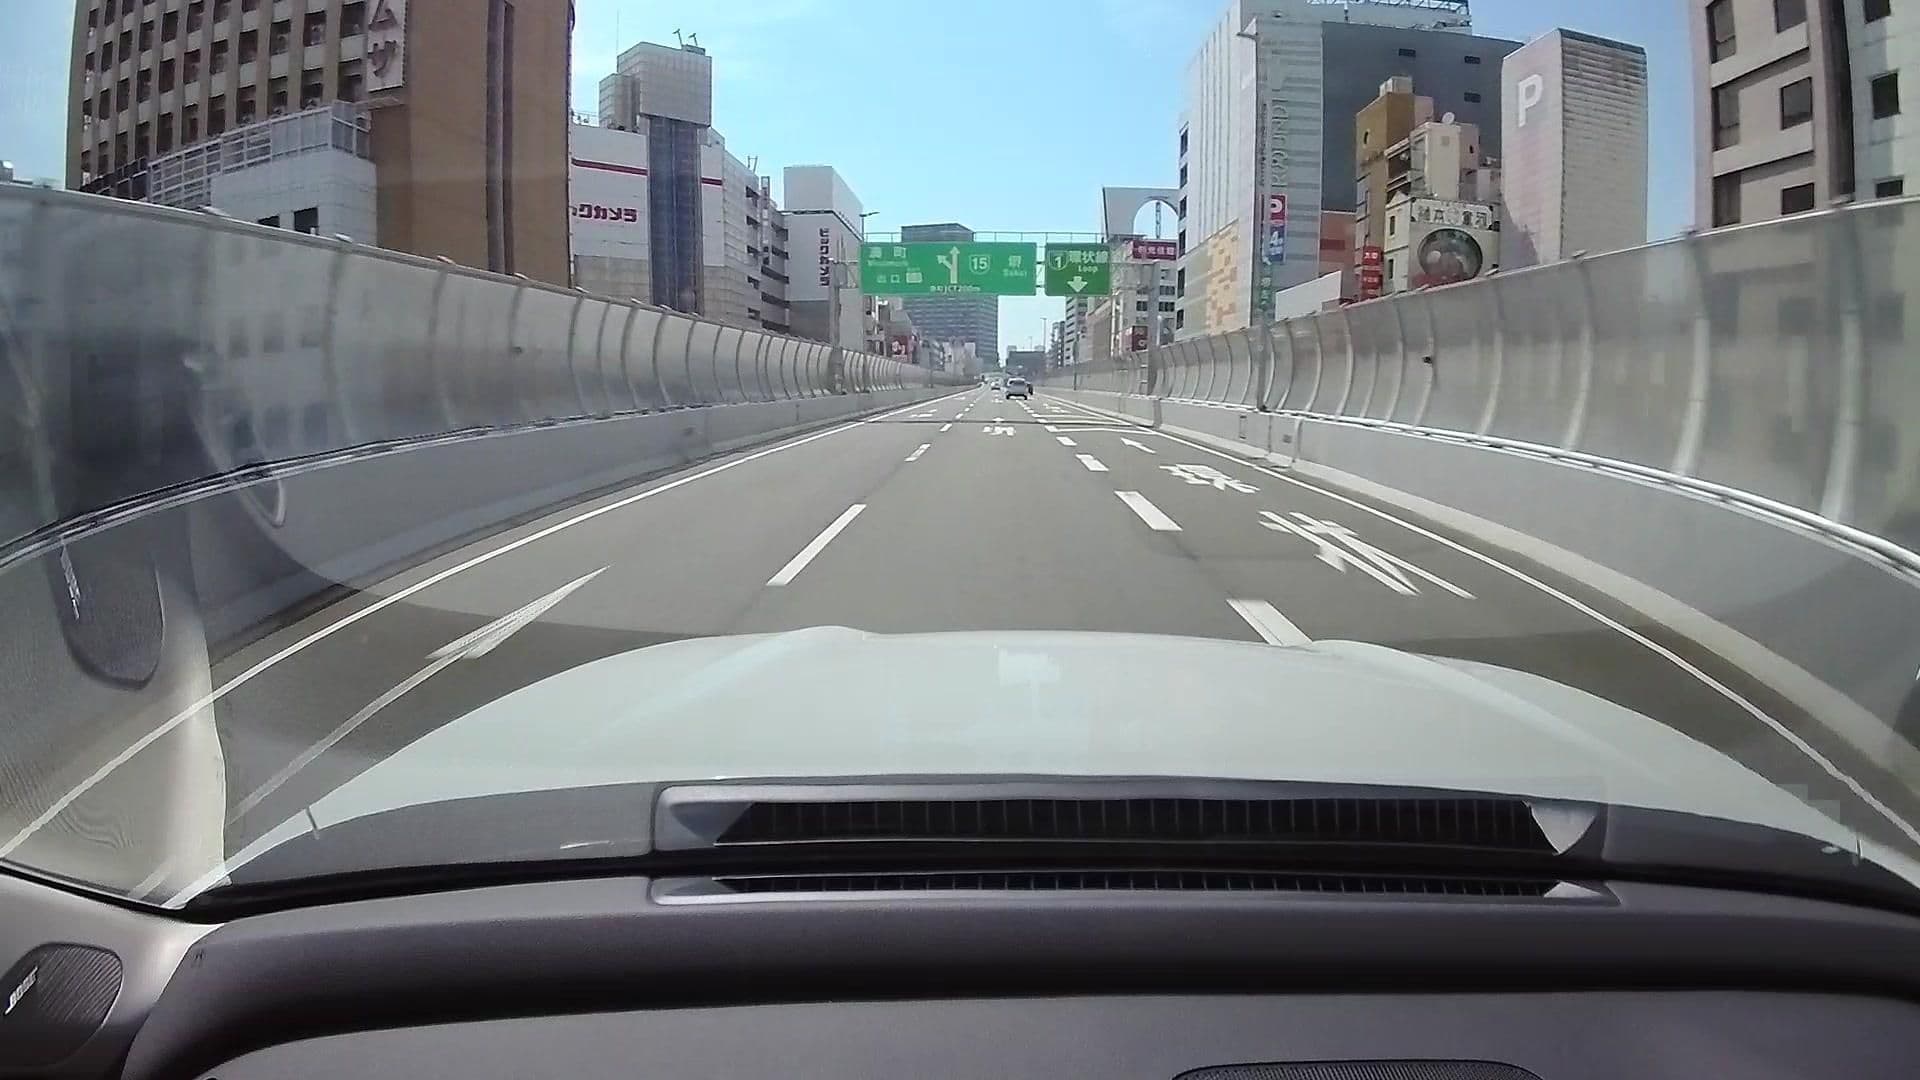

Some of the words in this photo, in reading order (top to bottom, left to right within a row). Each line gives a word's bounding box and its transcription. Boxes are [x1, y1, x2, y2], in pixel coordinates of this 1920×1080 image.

[1517, 73, 1544, 127] P
[971, 256, 988, 270] 15
[1054, 256, 1062, 268] 1
[1078, 265, 1098, 275] Loop
